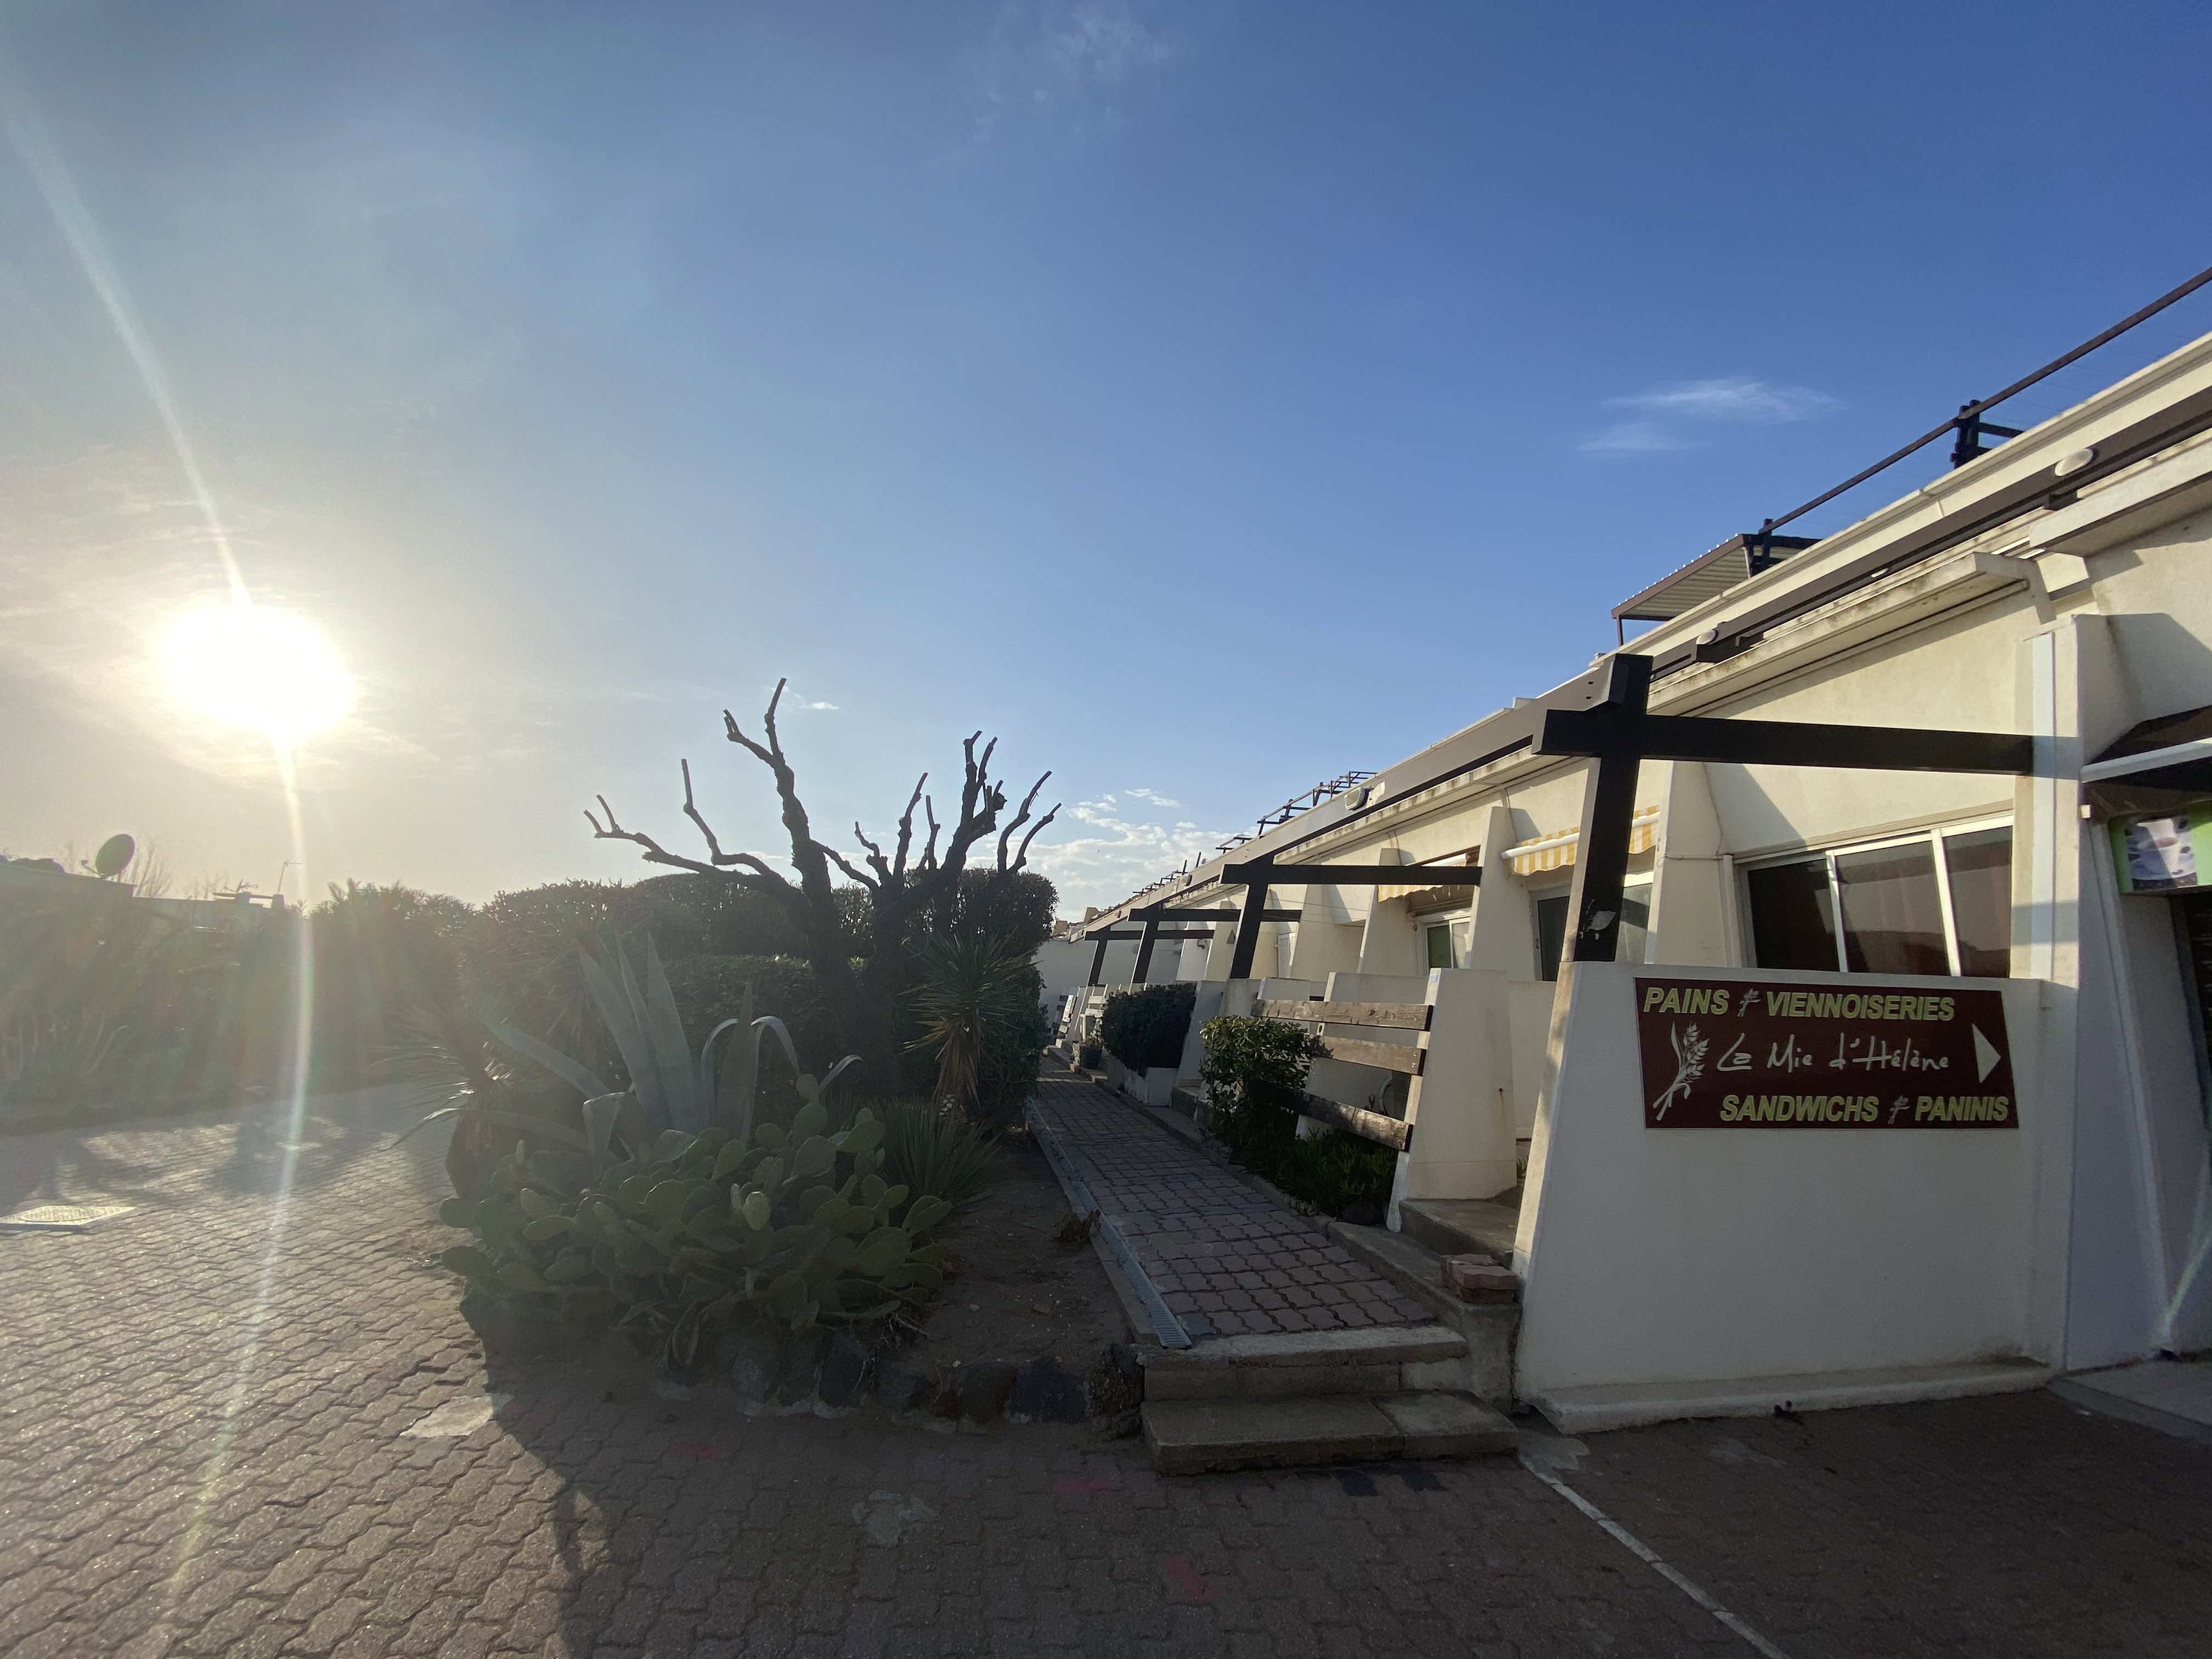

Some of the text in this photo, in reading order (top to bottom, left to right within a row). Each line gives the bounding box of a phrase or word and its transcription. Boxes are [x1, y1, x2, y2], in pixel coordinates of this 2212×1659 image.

[1643, 987, 1955, 1021] PAINS VIENNOISERIES
[1717, 1032, 1752, 1071] La
[1767, 1034, 1812, 1073] Mie
[1720, 1094, 2008, 1121] SANDWICHS PANINIS
